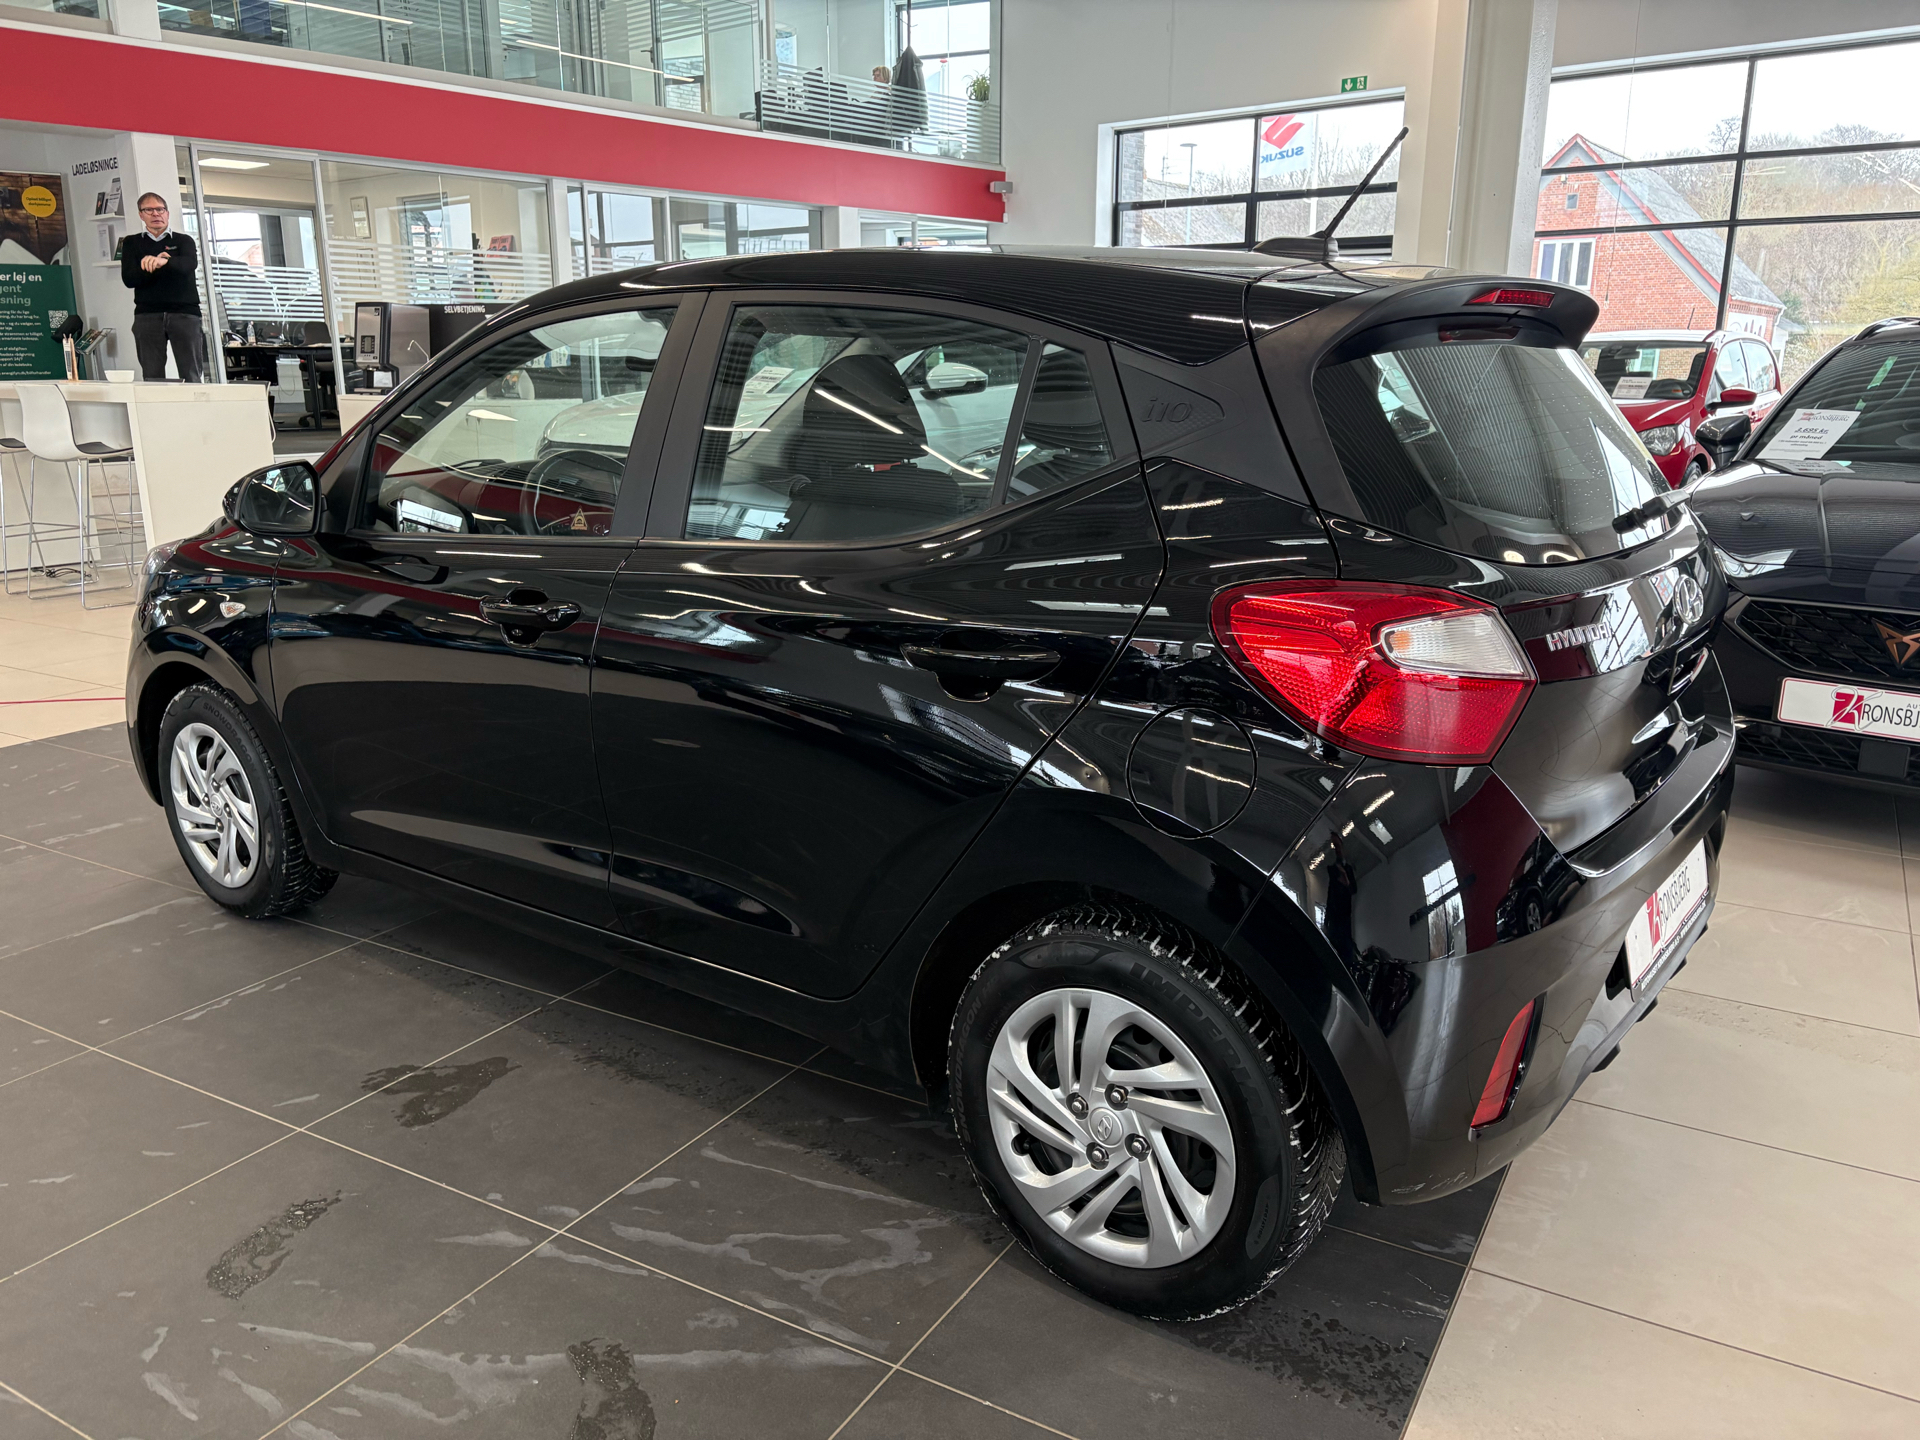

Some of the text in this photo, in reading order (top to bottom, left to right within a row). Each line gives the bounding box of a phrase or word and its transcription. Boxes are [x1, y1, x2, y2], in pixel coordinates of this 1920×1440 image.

[13, 271, 26, 284] lej
[28, 274, 42, 282] en
[443, 304, 486, 314] SELVBETJENING
[1142, 397, 1194, 423] i10
[1545, 621, 1612, 652] HYUNDAI
[1825, 685, 1920, 732] KRONSBJ
[1906, 702, 1920, 710] AU
[202, 702, 257, 771] SNOWDRAGON
[1129, 962, 1271, 1132] IMPERIAL
[954, 997, 983, 1145] SNOWDRAGON
